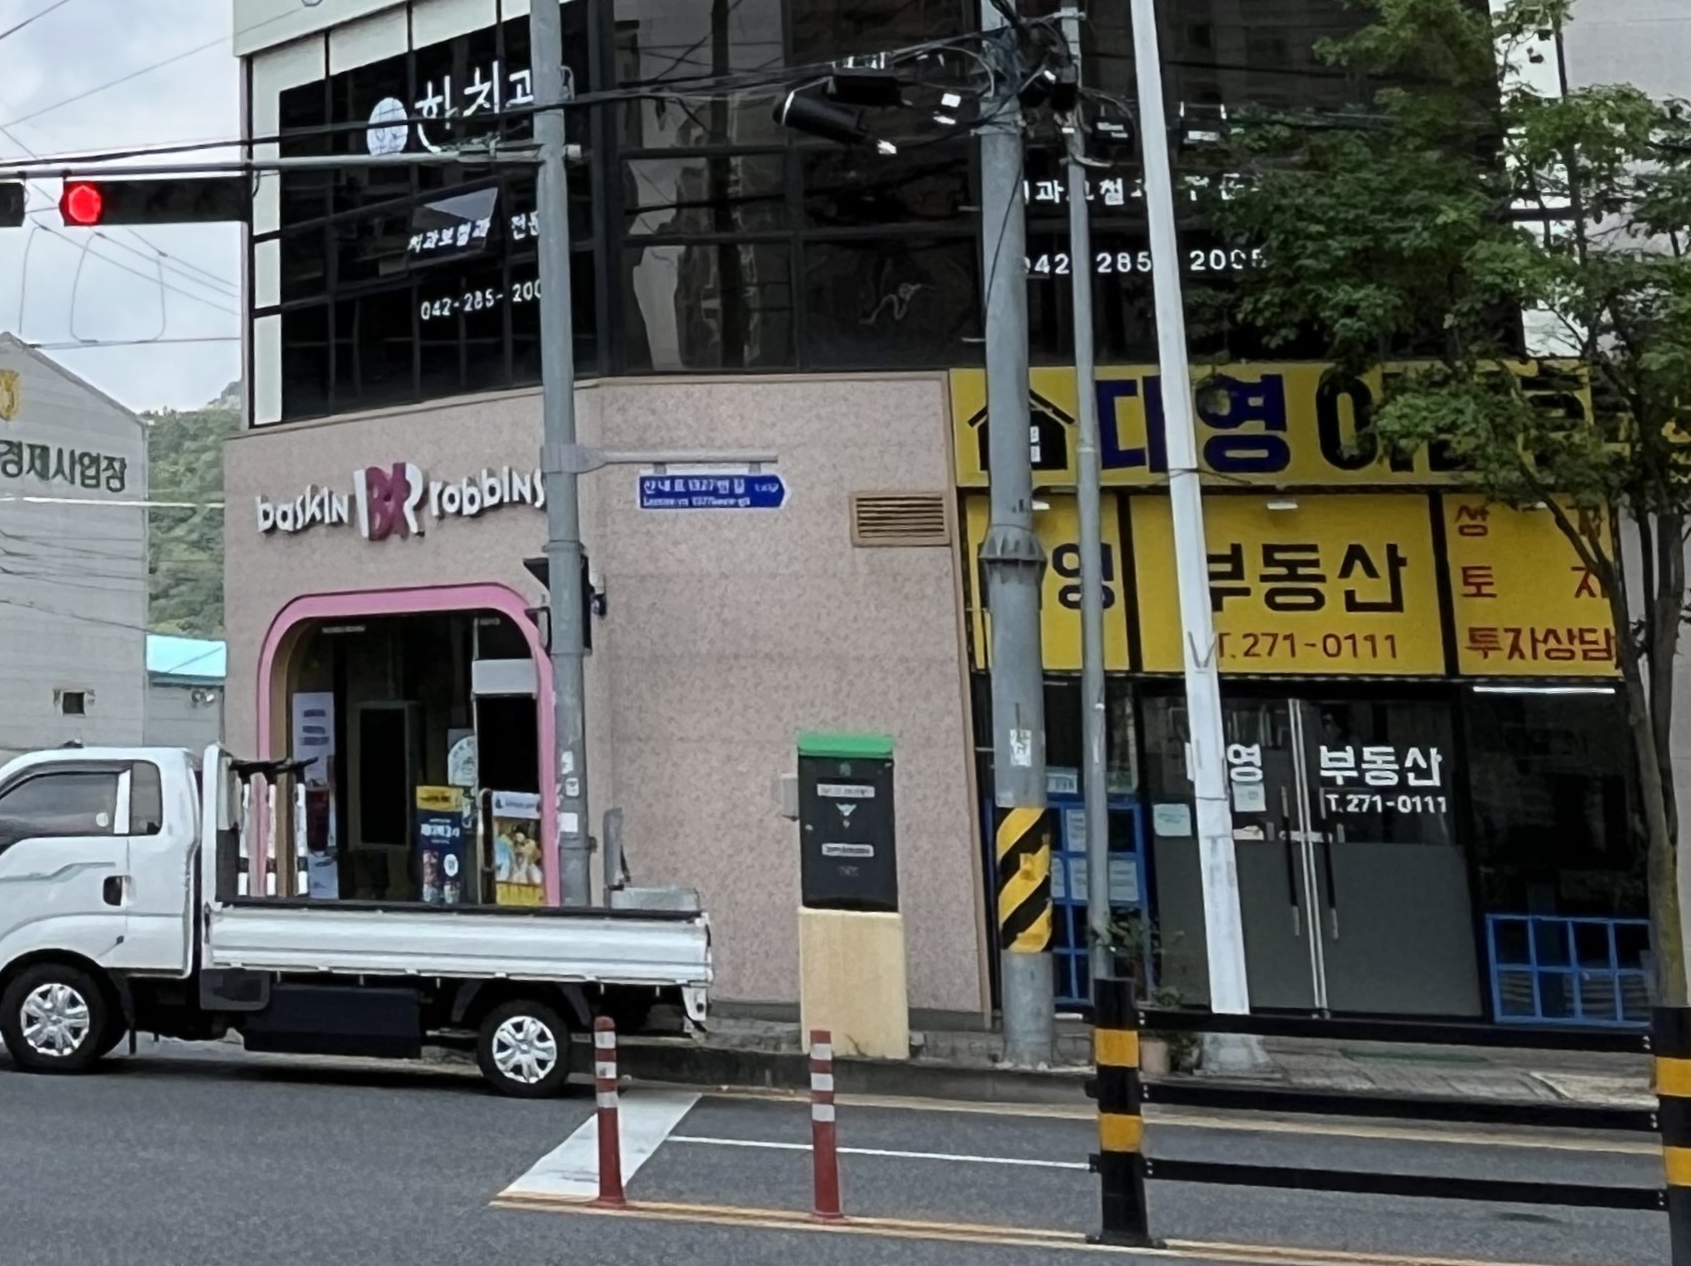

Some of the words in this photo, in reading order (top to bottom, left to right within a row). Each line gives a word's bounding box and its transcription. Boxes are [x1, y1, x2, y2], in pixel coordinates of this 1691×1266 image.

[1217, 632, 1398, 660] T.271-0111
[1464, 626, 1618, 662] 투자상담
[1319, 744, 1443, 787] 부동산
[1325, 793, 1448, 814] T.271-0111
